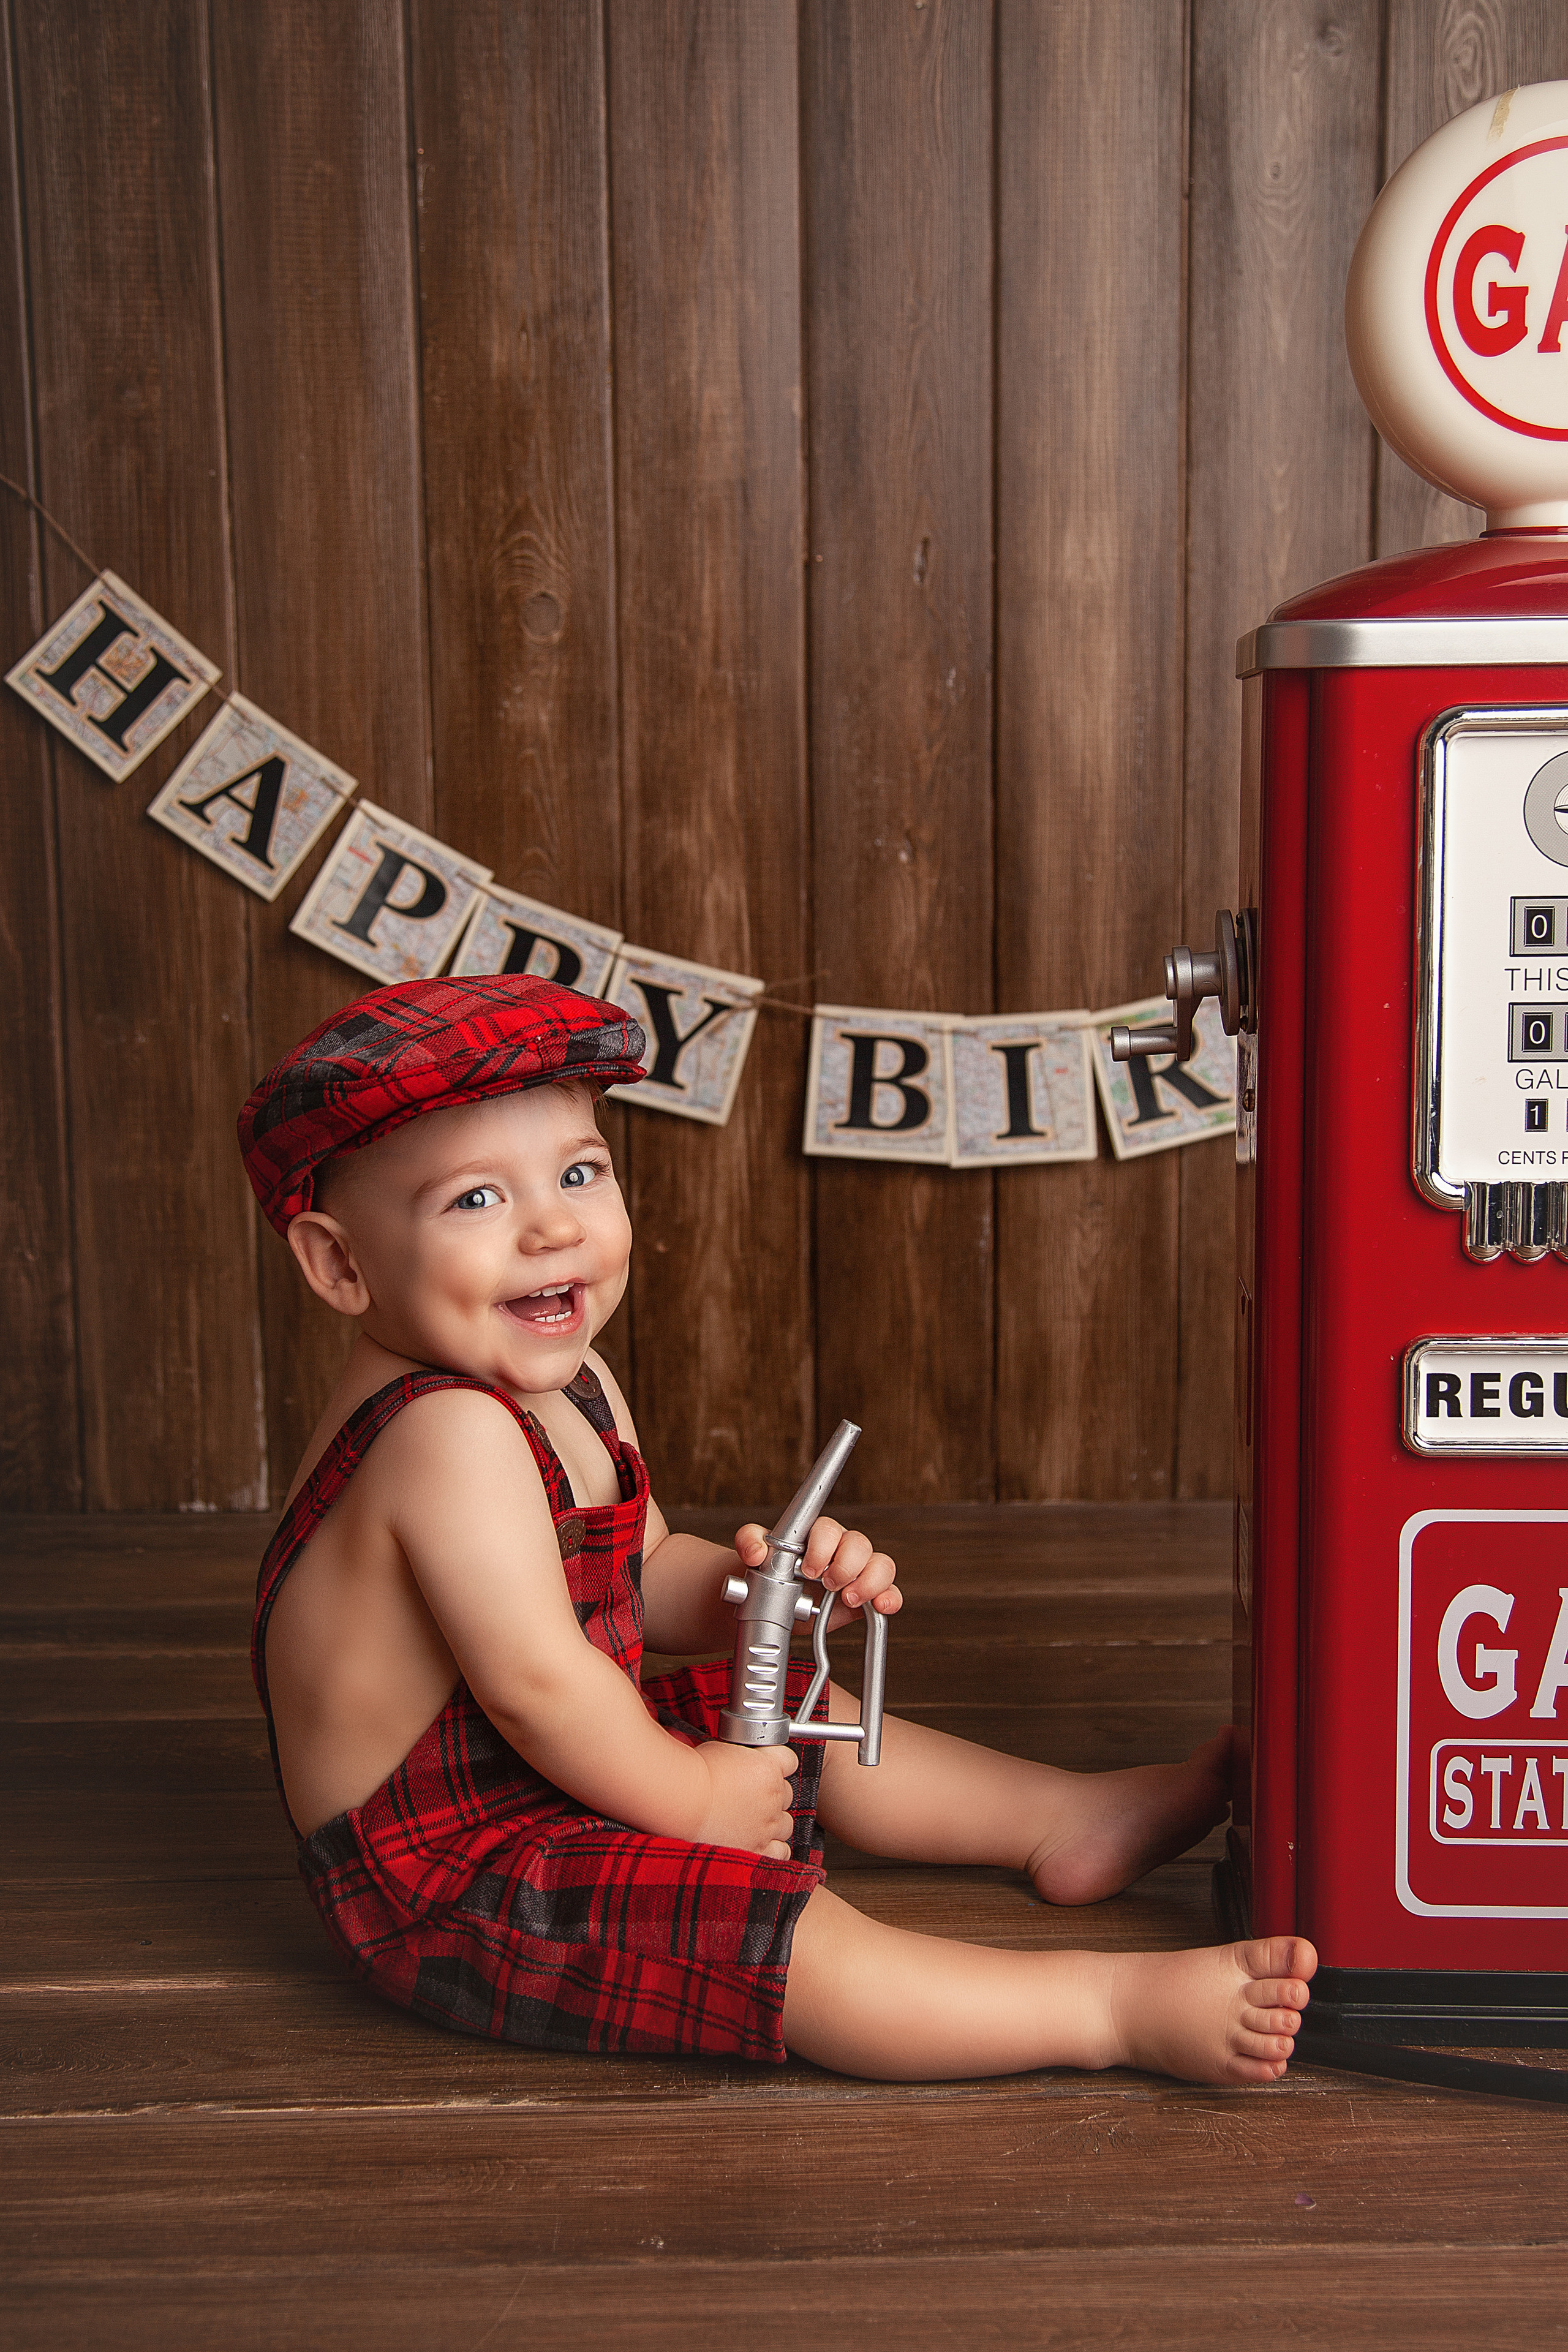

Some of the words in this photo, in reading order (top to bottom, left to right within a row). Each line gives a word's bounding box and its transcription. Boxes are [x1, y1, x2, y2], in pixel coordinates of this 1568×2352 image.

[35, 599, 736, 1090] HAPPY
[834, 1023, 1231, 1139] BIR
[1531, 914, 1547, 938] 0
[1504, 967, 1568, 991] THIS
[1529, 1020, 1545, 1044] 0
[1515, 1068, 1568, 1090] GAL
[1530, 1105, 1539, 1126] 1
[1498, 1150, 1556, 1165] CENTS
